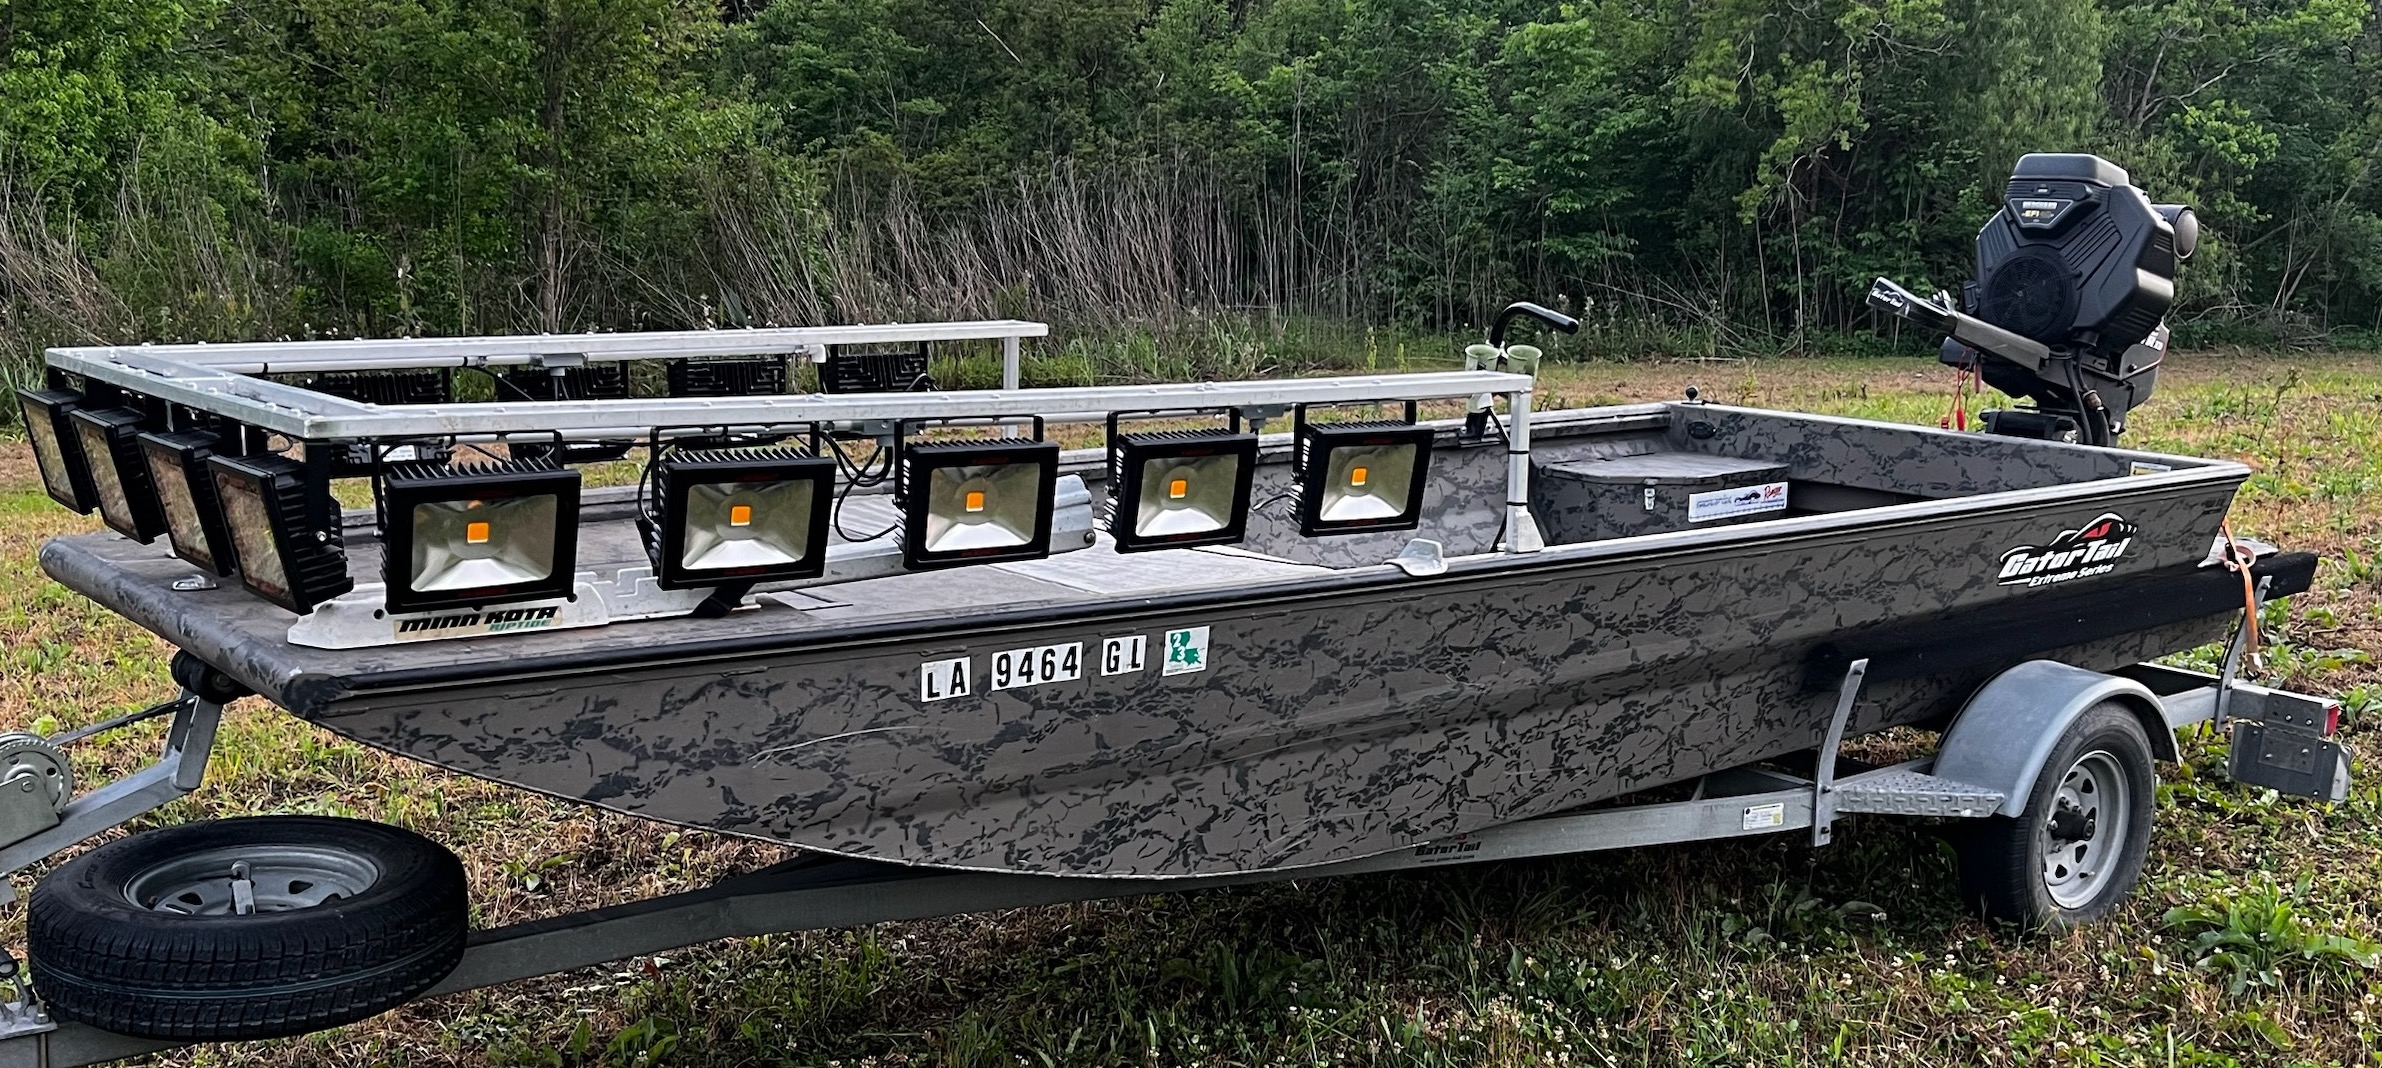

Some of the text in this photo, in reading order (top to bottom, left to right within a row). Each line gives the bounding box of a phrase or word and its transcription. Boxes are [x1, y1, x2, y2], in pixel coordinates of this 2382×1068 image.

[1998, 537, 2132, 579] GatorTail
[2028, 563, 2115, 588] Extreme Series
[484, 605, 560, 625] KOTA
[926, 638, 1142, 699] LA 9464 GL
